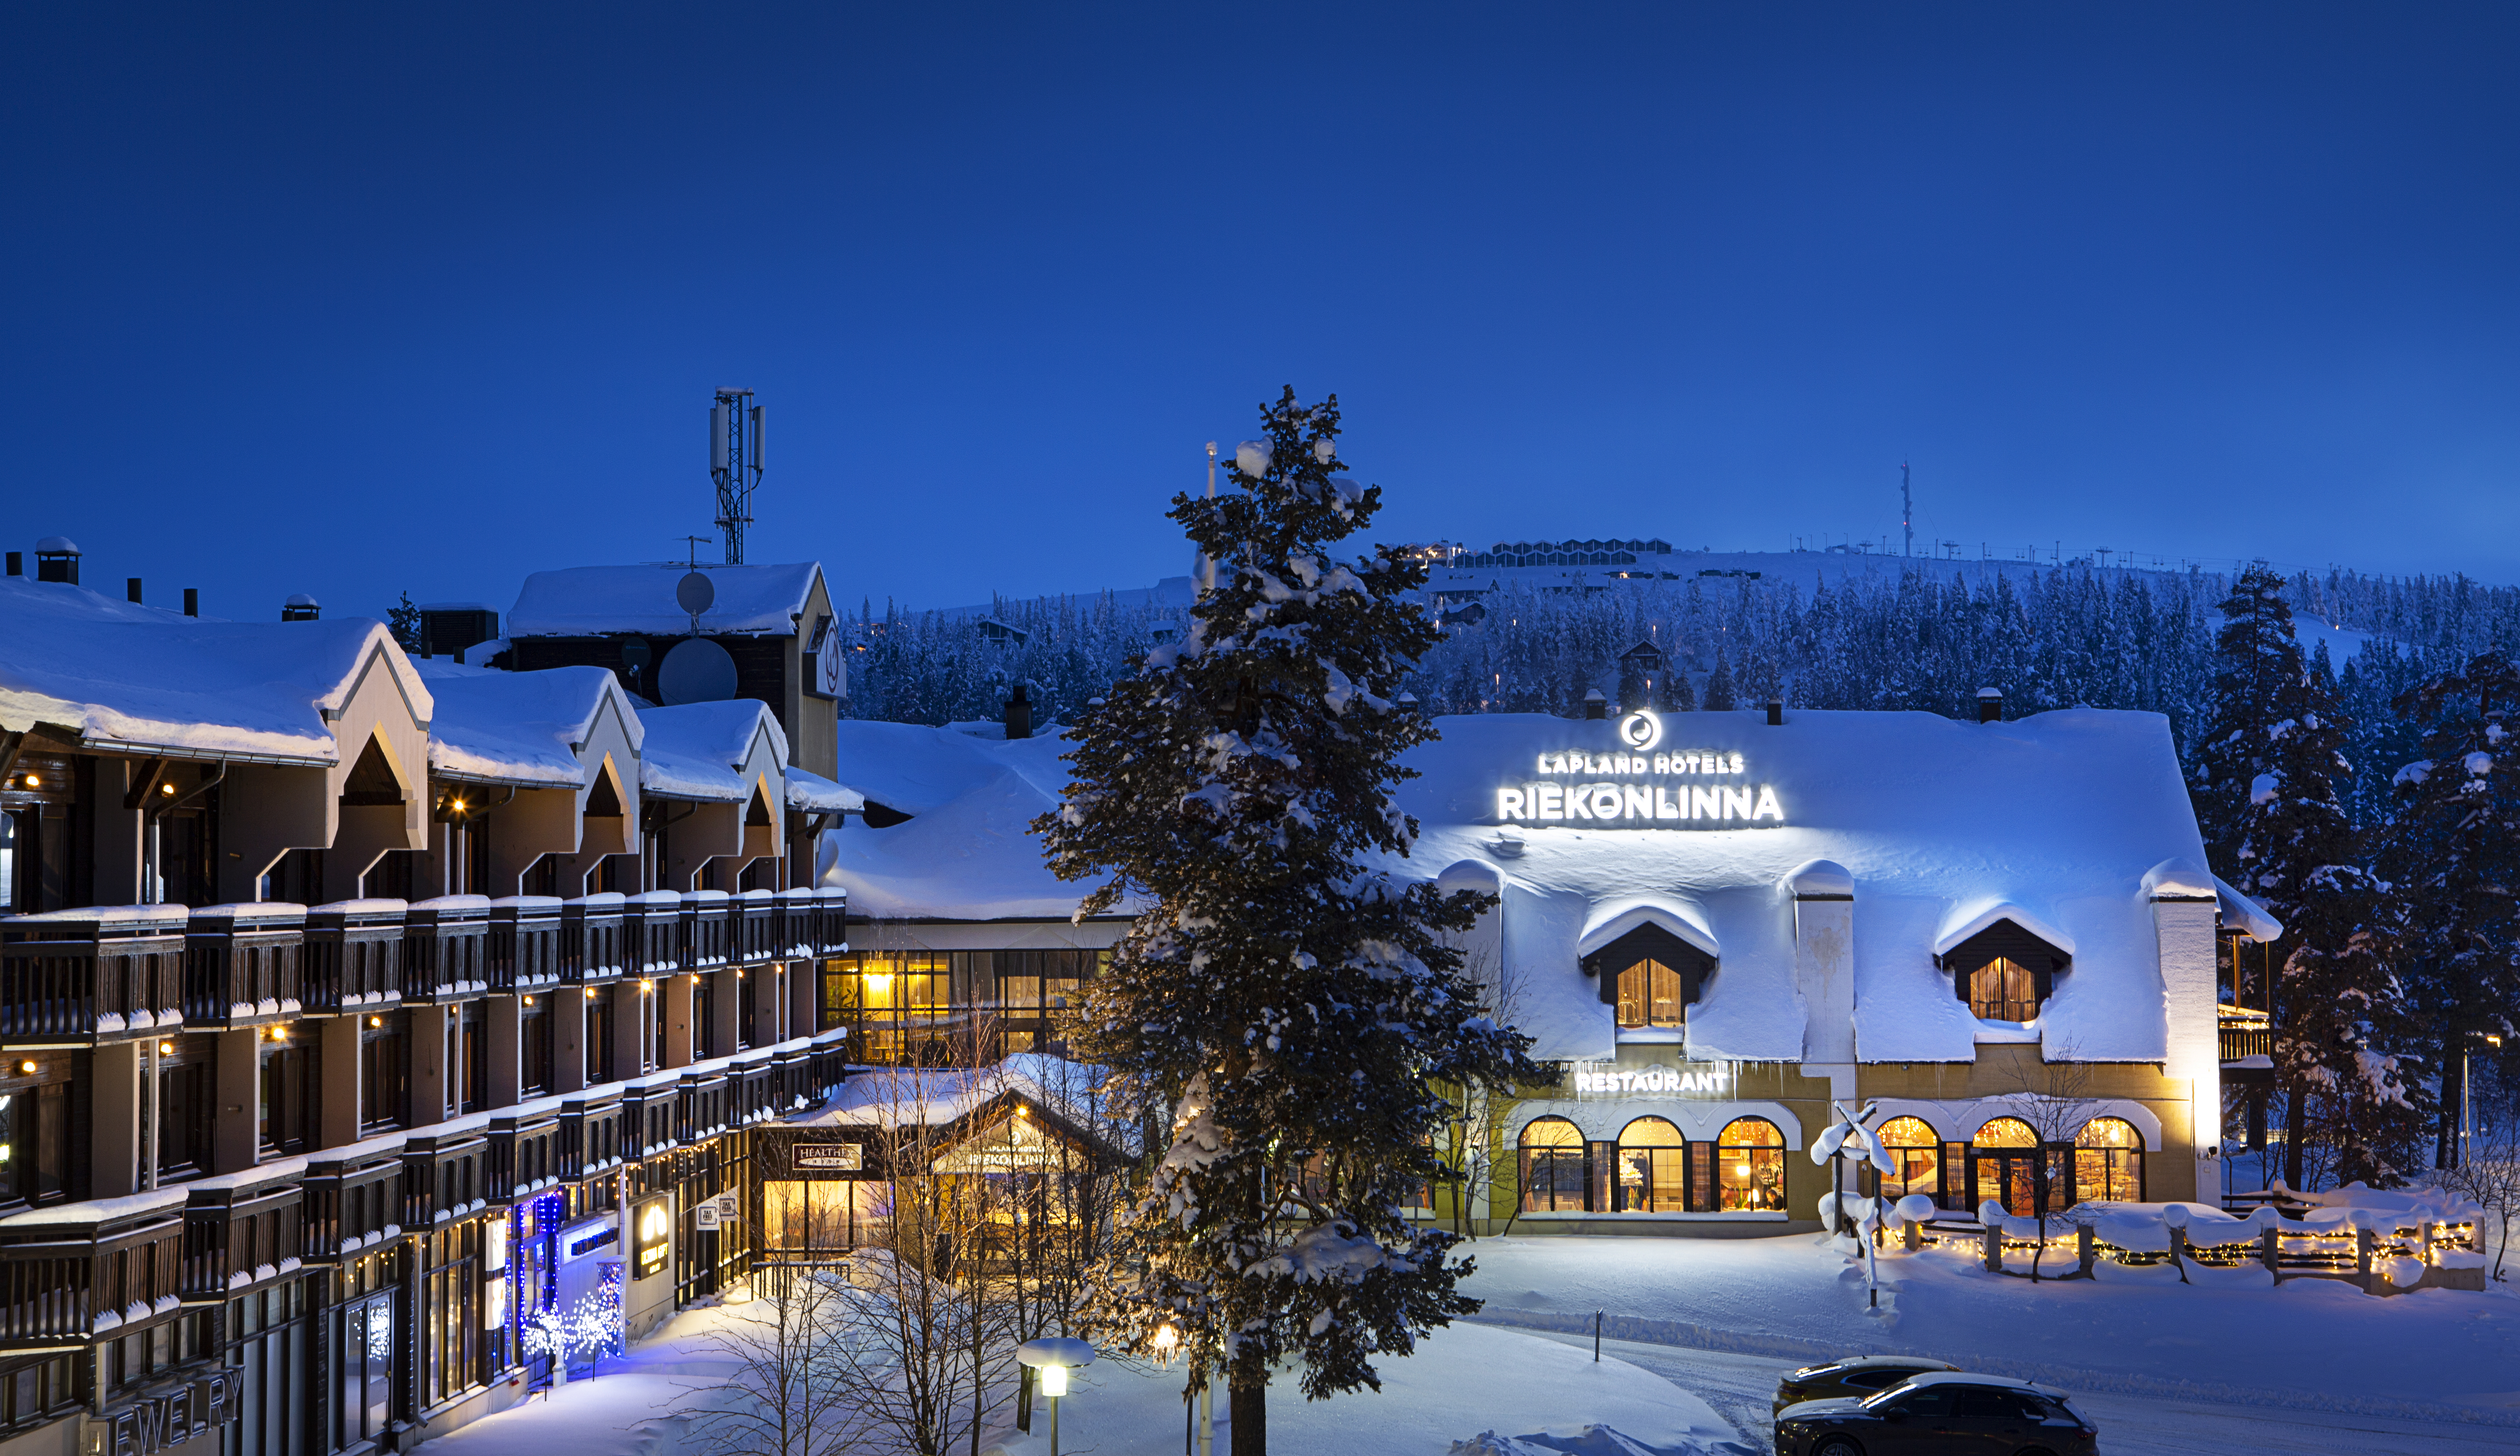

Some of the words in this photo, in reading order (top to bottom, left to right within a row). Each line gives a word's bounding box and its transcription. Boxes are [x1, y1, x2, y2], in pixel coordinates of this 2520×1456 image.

[1539, 757, 1647, 773] LAPLAND
[1655, 757, 1744, 773] HOTELS
[1499, 787, 1784, 820] RIEKONLINNA
[1576, 1072, 1728, 1092] RESTAURANT
[658, 1242, 668, 1259] GIFT
